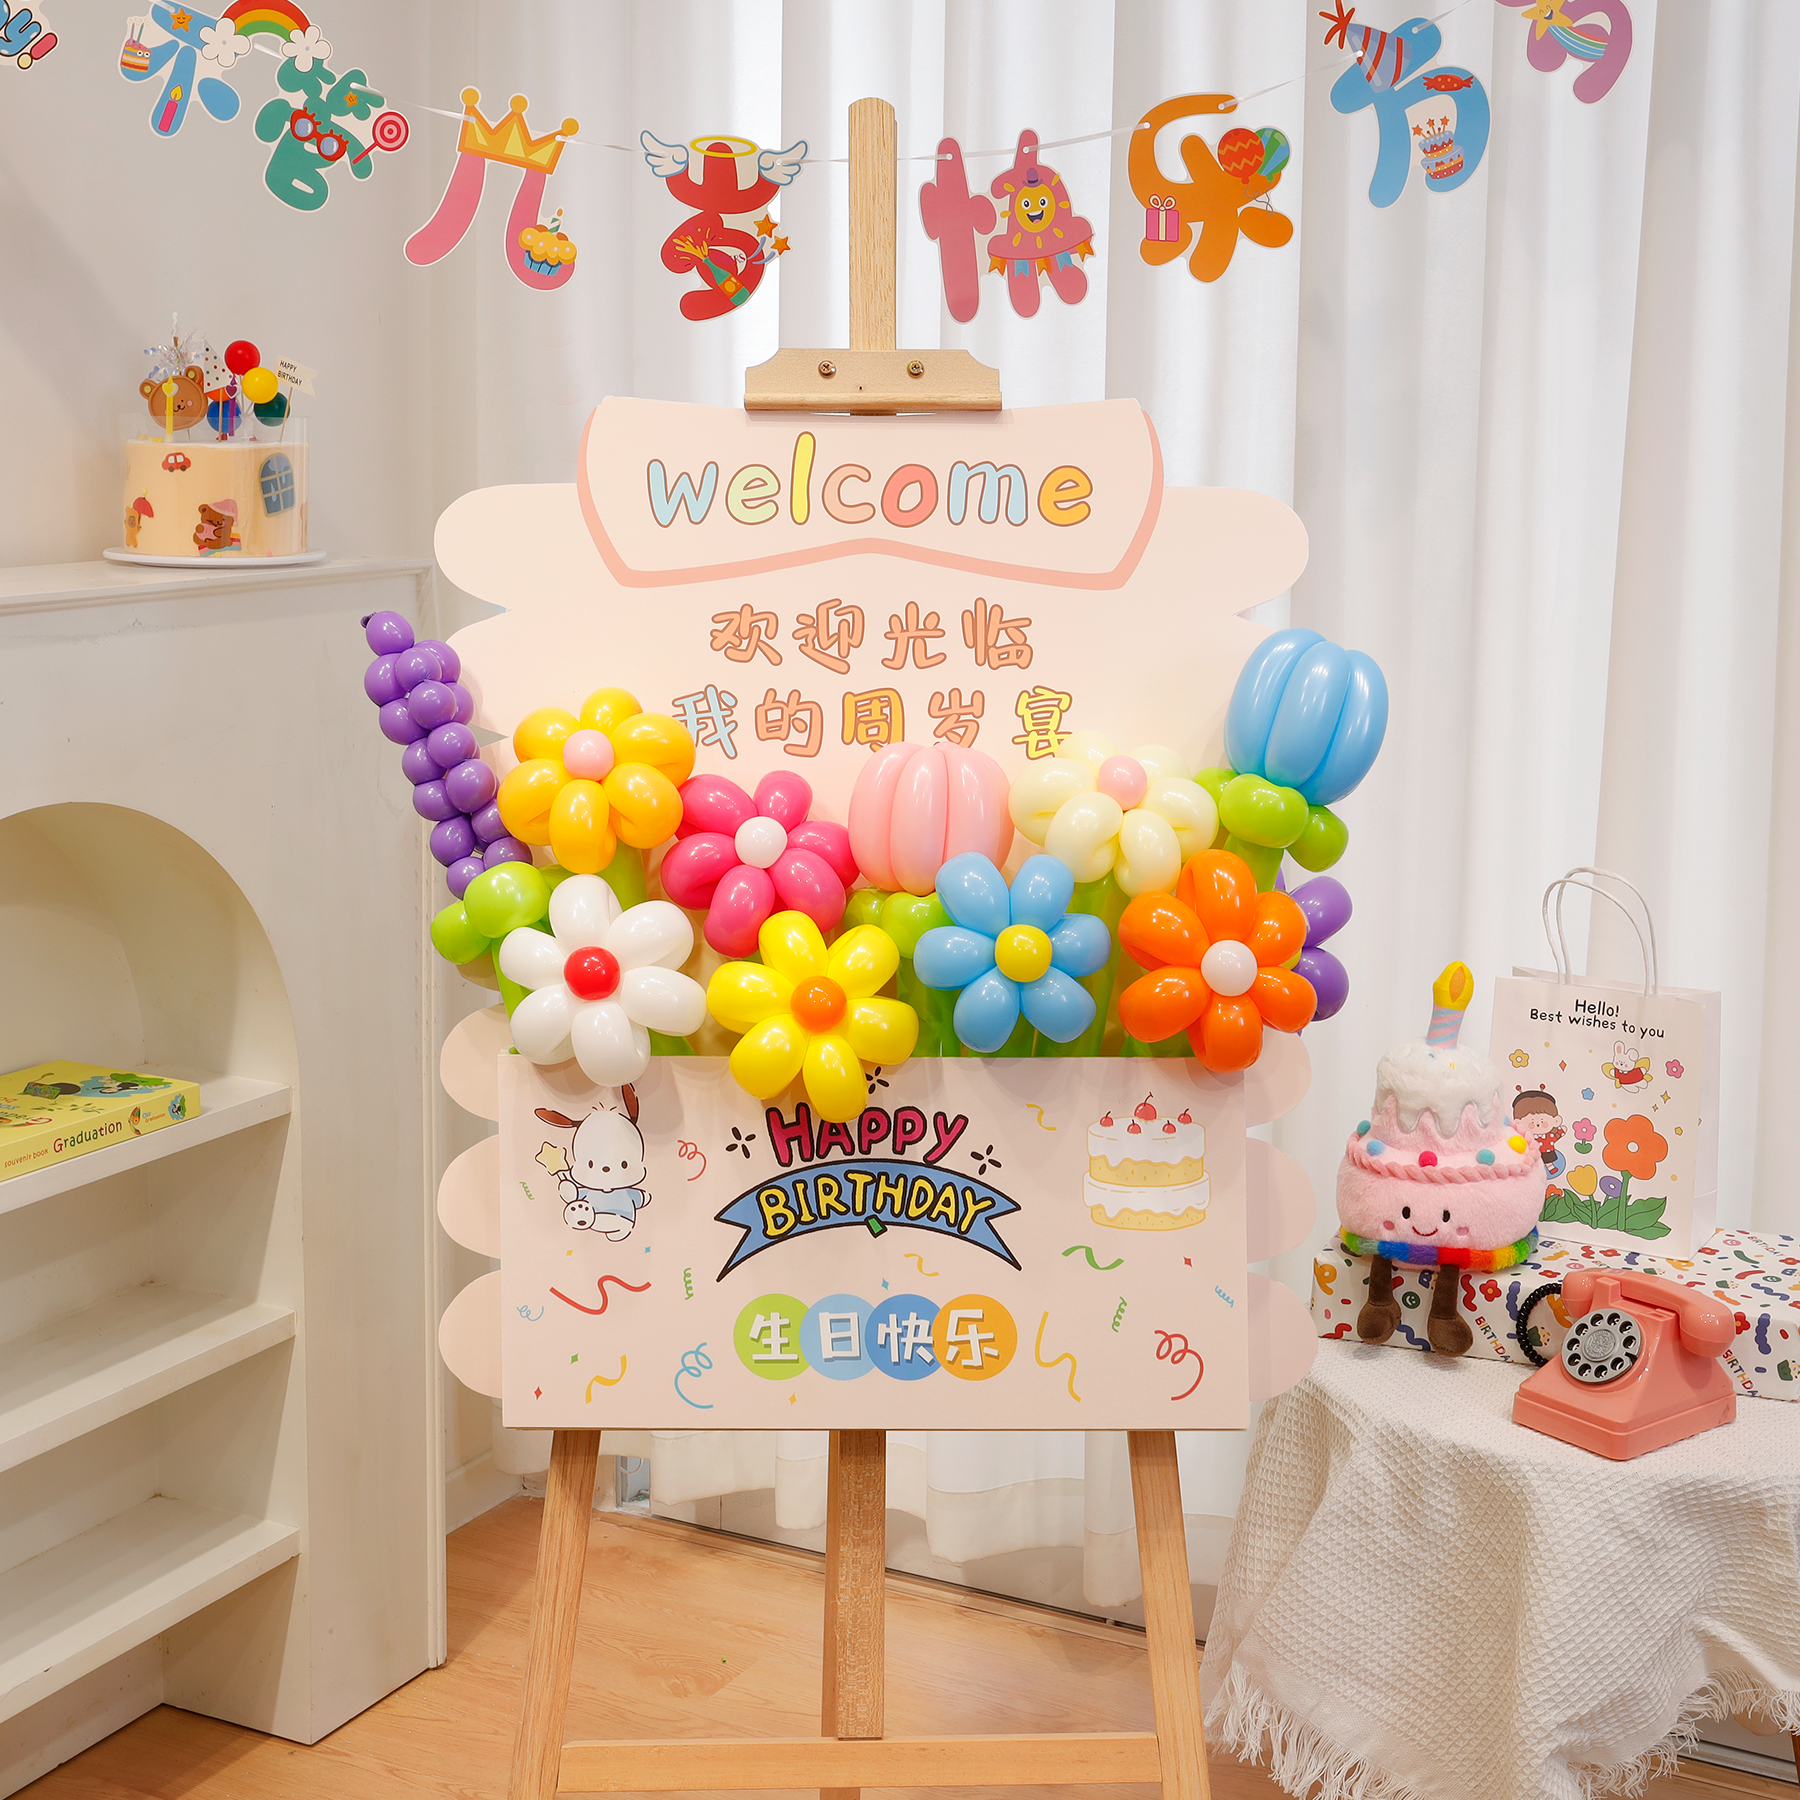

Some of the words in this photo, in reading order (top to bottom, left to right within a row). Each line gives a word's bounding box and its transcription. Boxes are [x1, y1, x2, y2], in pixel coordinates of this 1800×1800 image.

[277, 370, 303, 386] BIRTHDAY
[279, 359, 298, 373] HAPPY
[647, 431, 1094, 528] welcome
[710, 597, 1034, 675] 欢迎光临
[672, 684, 1073, 760] 我的周岁宴
[1530, 1008, 1563, 1024] Best
[1568, 1014, 1616, 1031] wishes
[1622, 1019, 1636, 1034] to
[1639, 1026, 1665, 1040] you
[1574, 998, 1620, 1018] Hello!
[53, 1119, 122, 1154] Graduation
[766, 1102, 969, 1167] HAPPY
[756, 1169, 996, 1239] BIRTHDAY
[748, 1308, 999, 1367] 生日快乐
[1474, 1316, 1516, 1363] BIRTHDA
[1722, 1349, 1763, 1398] BIRTHDA
